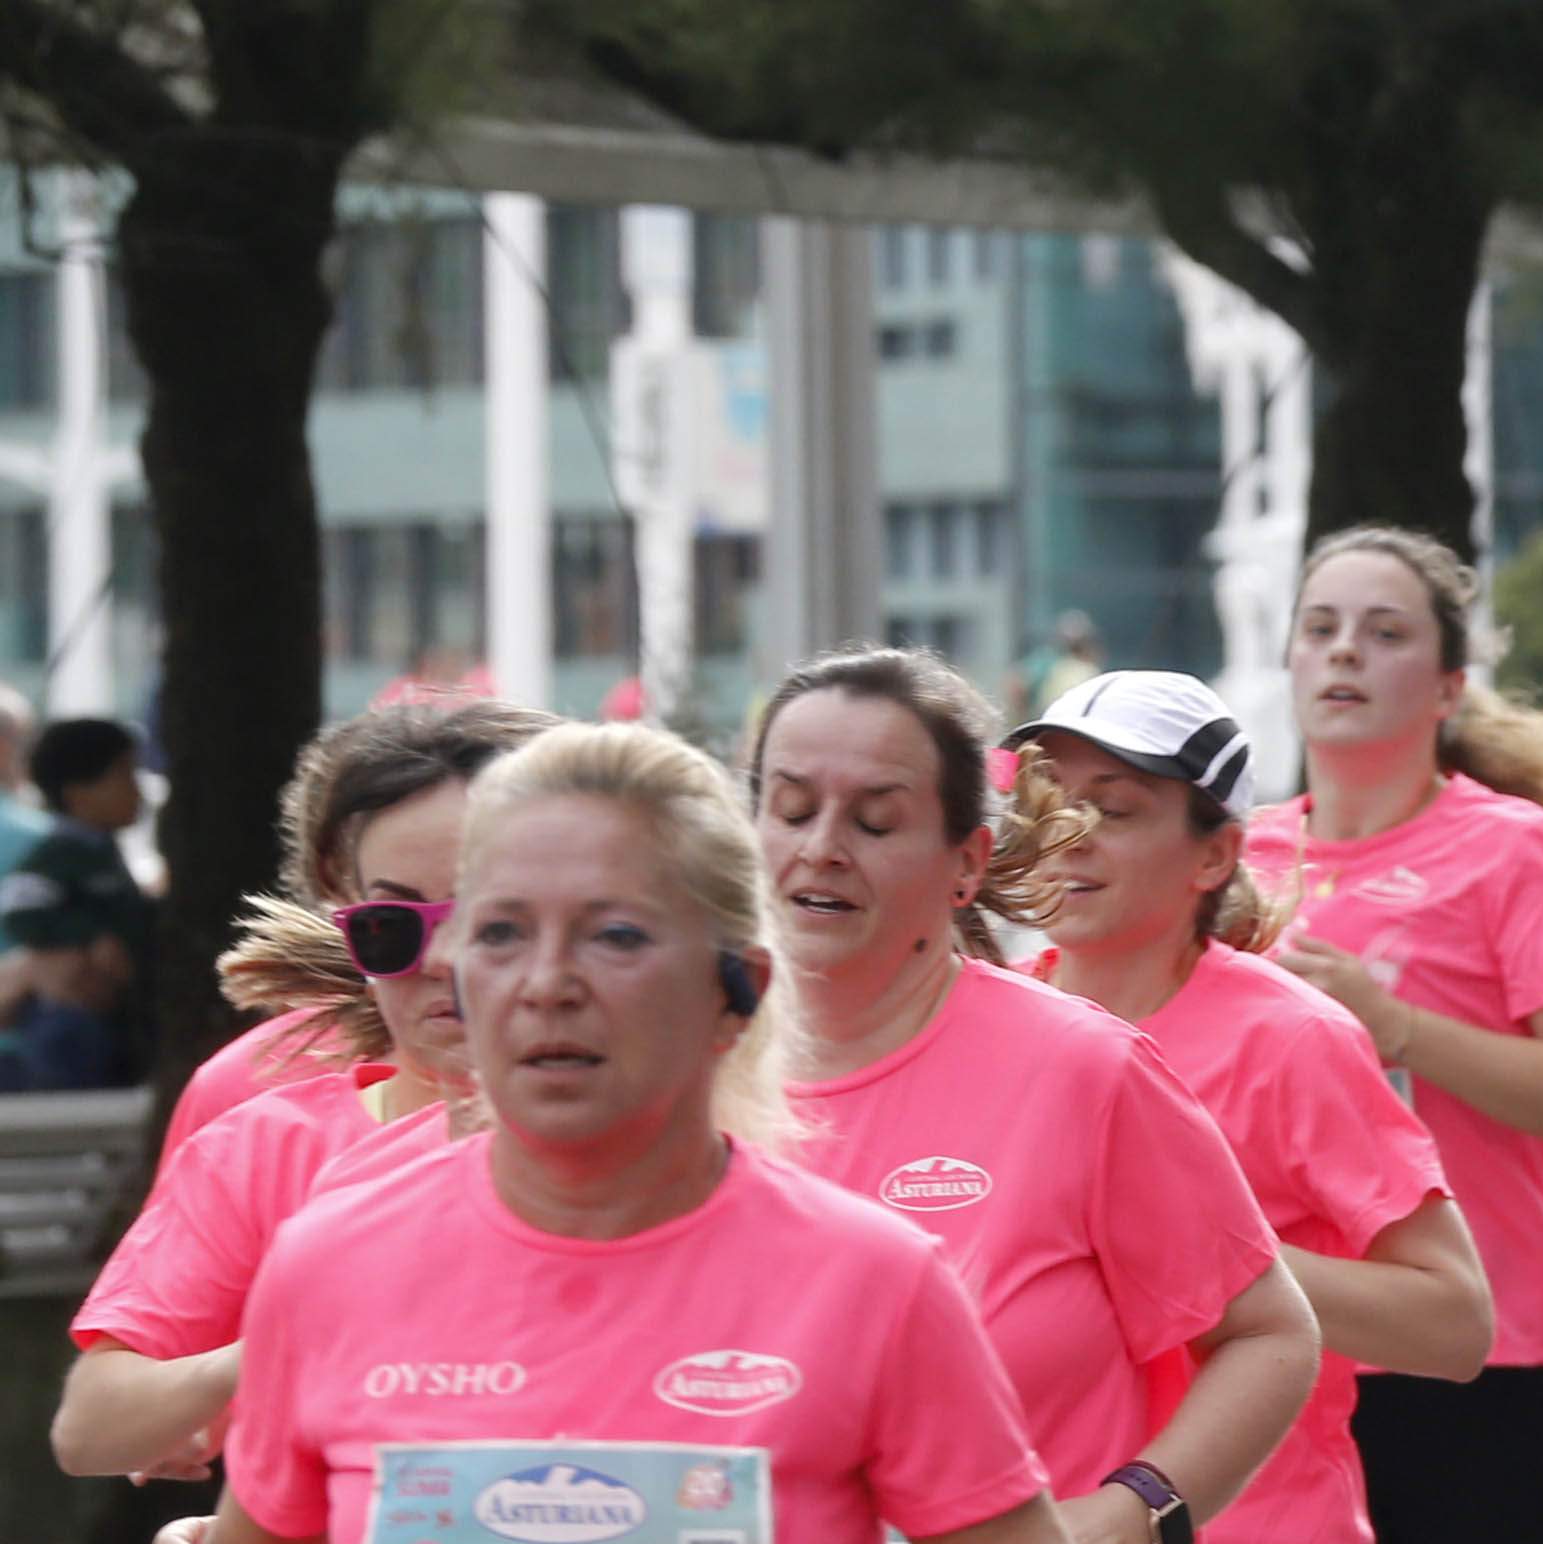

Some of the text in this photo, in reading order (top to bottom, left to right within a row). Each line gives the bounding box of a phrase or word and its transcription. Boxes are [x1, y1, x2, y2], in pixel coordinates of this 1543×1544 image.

[886, 1178, 983, 1200] ASTURIANA
[362, 1360, 526, 1400] OYSHO
[483, 1495, 637, 1526] ASTURIANA
